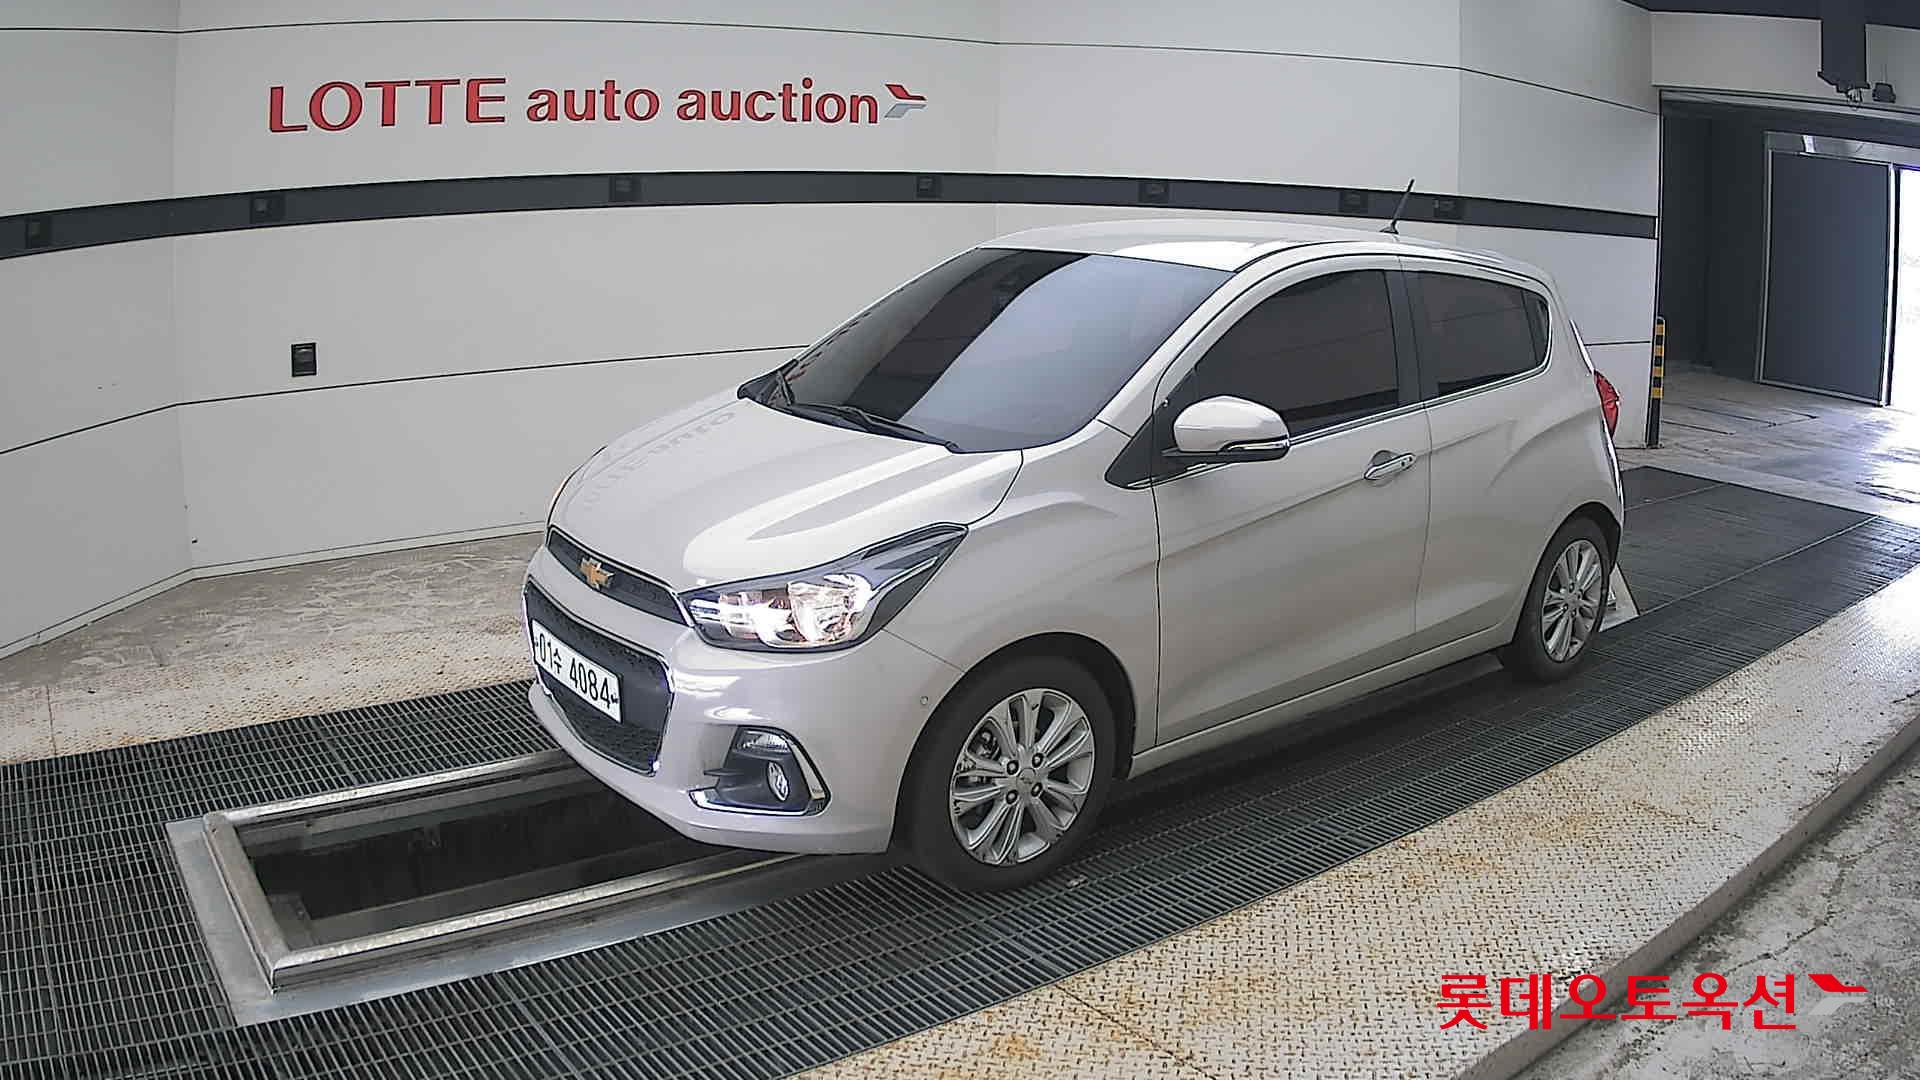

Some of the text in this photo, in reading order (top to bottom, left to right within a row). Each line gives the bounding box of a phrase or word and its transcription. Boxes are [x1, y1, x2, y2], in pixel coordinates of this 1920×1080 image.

[269, 78, 879, 133] LOTTE auto auction
[539, 632, 612, 709] 01수 4084
